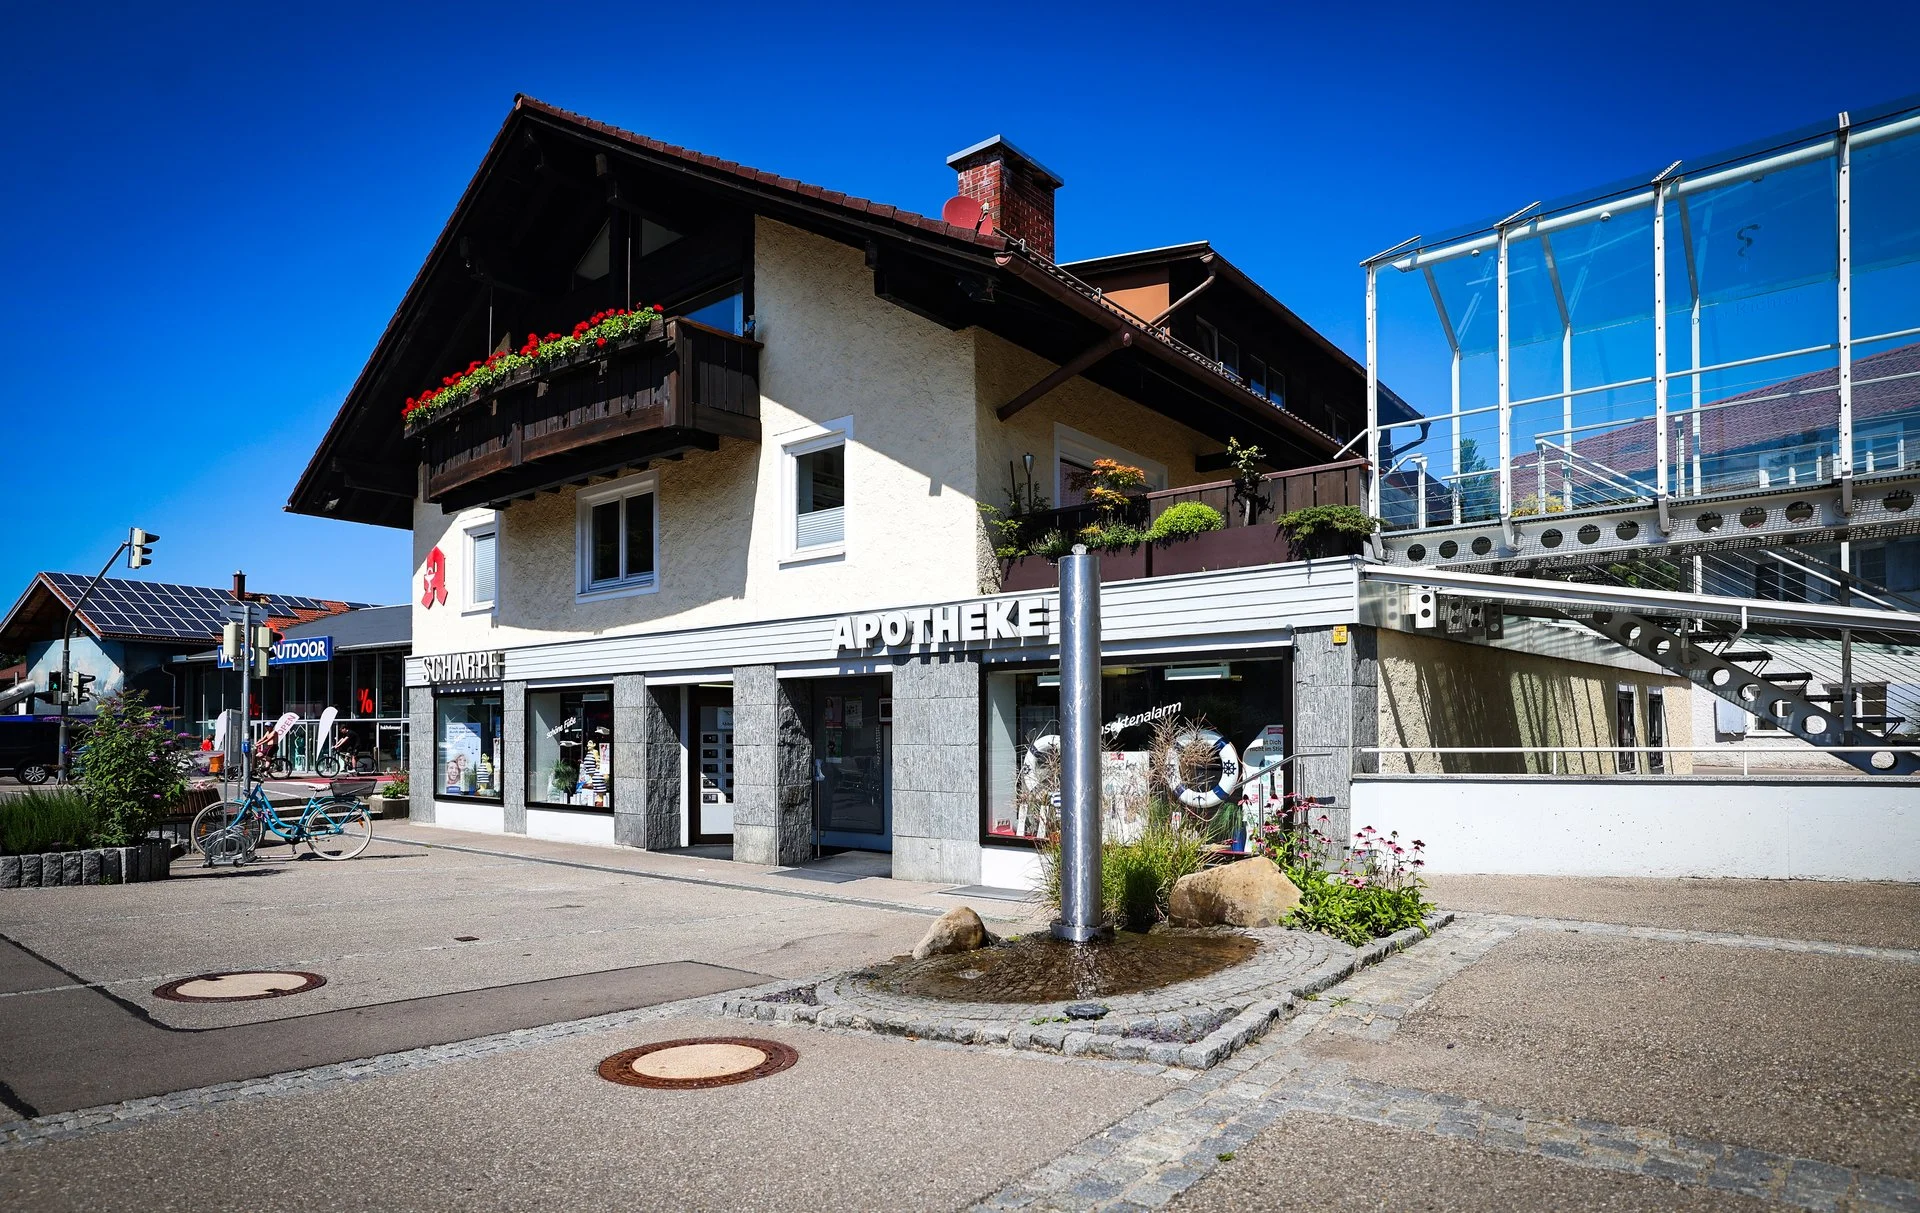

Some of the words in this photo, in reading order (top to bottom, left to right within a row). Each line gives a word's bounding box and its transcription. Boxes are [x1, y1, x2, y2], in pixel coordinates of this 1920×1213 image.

[831, 598, 1046, 650] APOTHEKE
[268, 640, 326, 660] OUTDOOR
[422, 650, 498, 682] SCHARPF
[277, 714, 296, 737] OPEN
